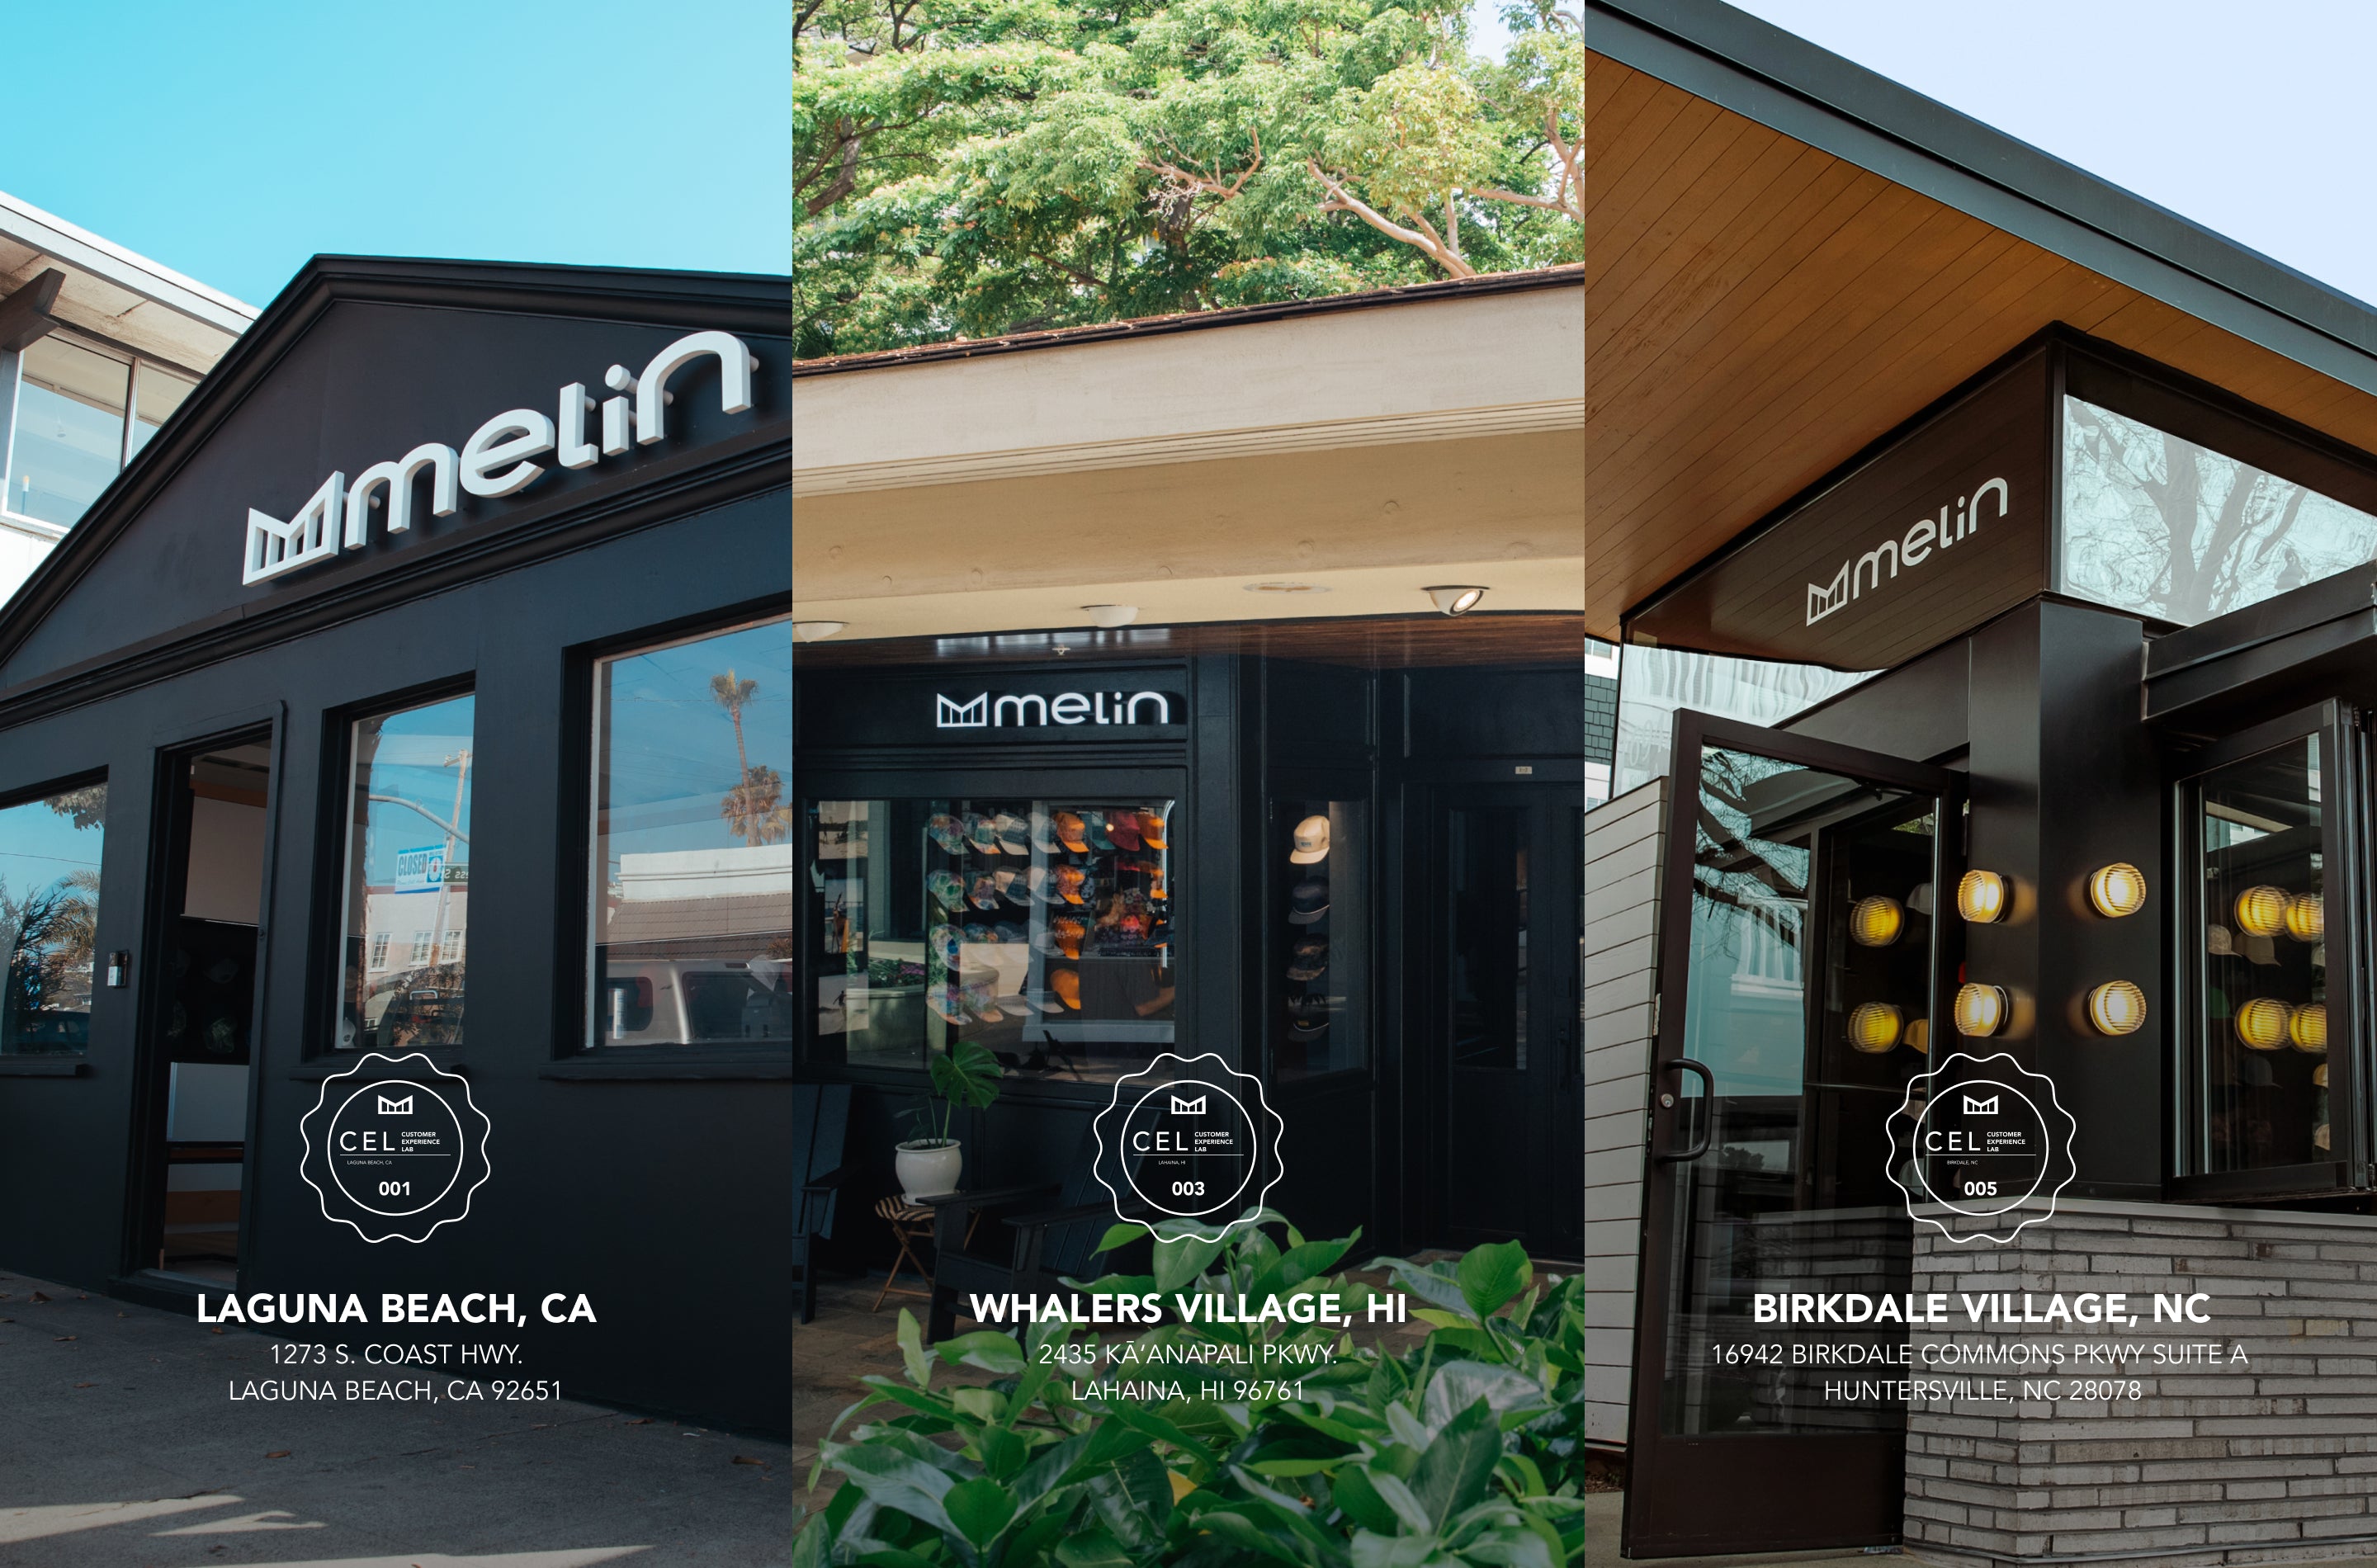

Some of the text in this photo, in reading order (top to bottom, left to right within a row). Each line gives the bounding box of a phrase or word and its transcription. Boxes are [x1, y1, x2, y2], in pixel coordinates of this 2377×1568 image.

[344, 330, 753, 549] melin
[1852, 477, 2008, 601] melin
[994, 691, 1169, 727] melin
[398, 853, 428, 876] CLOSED
